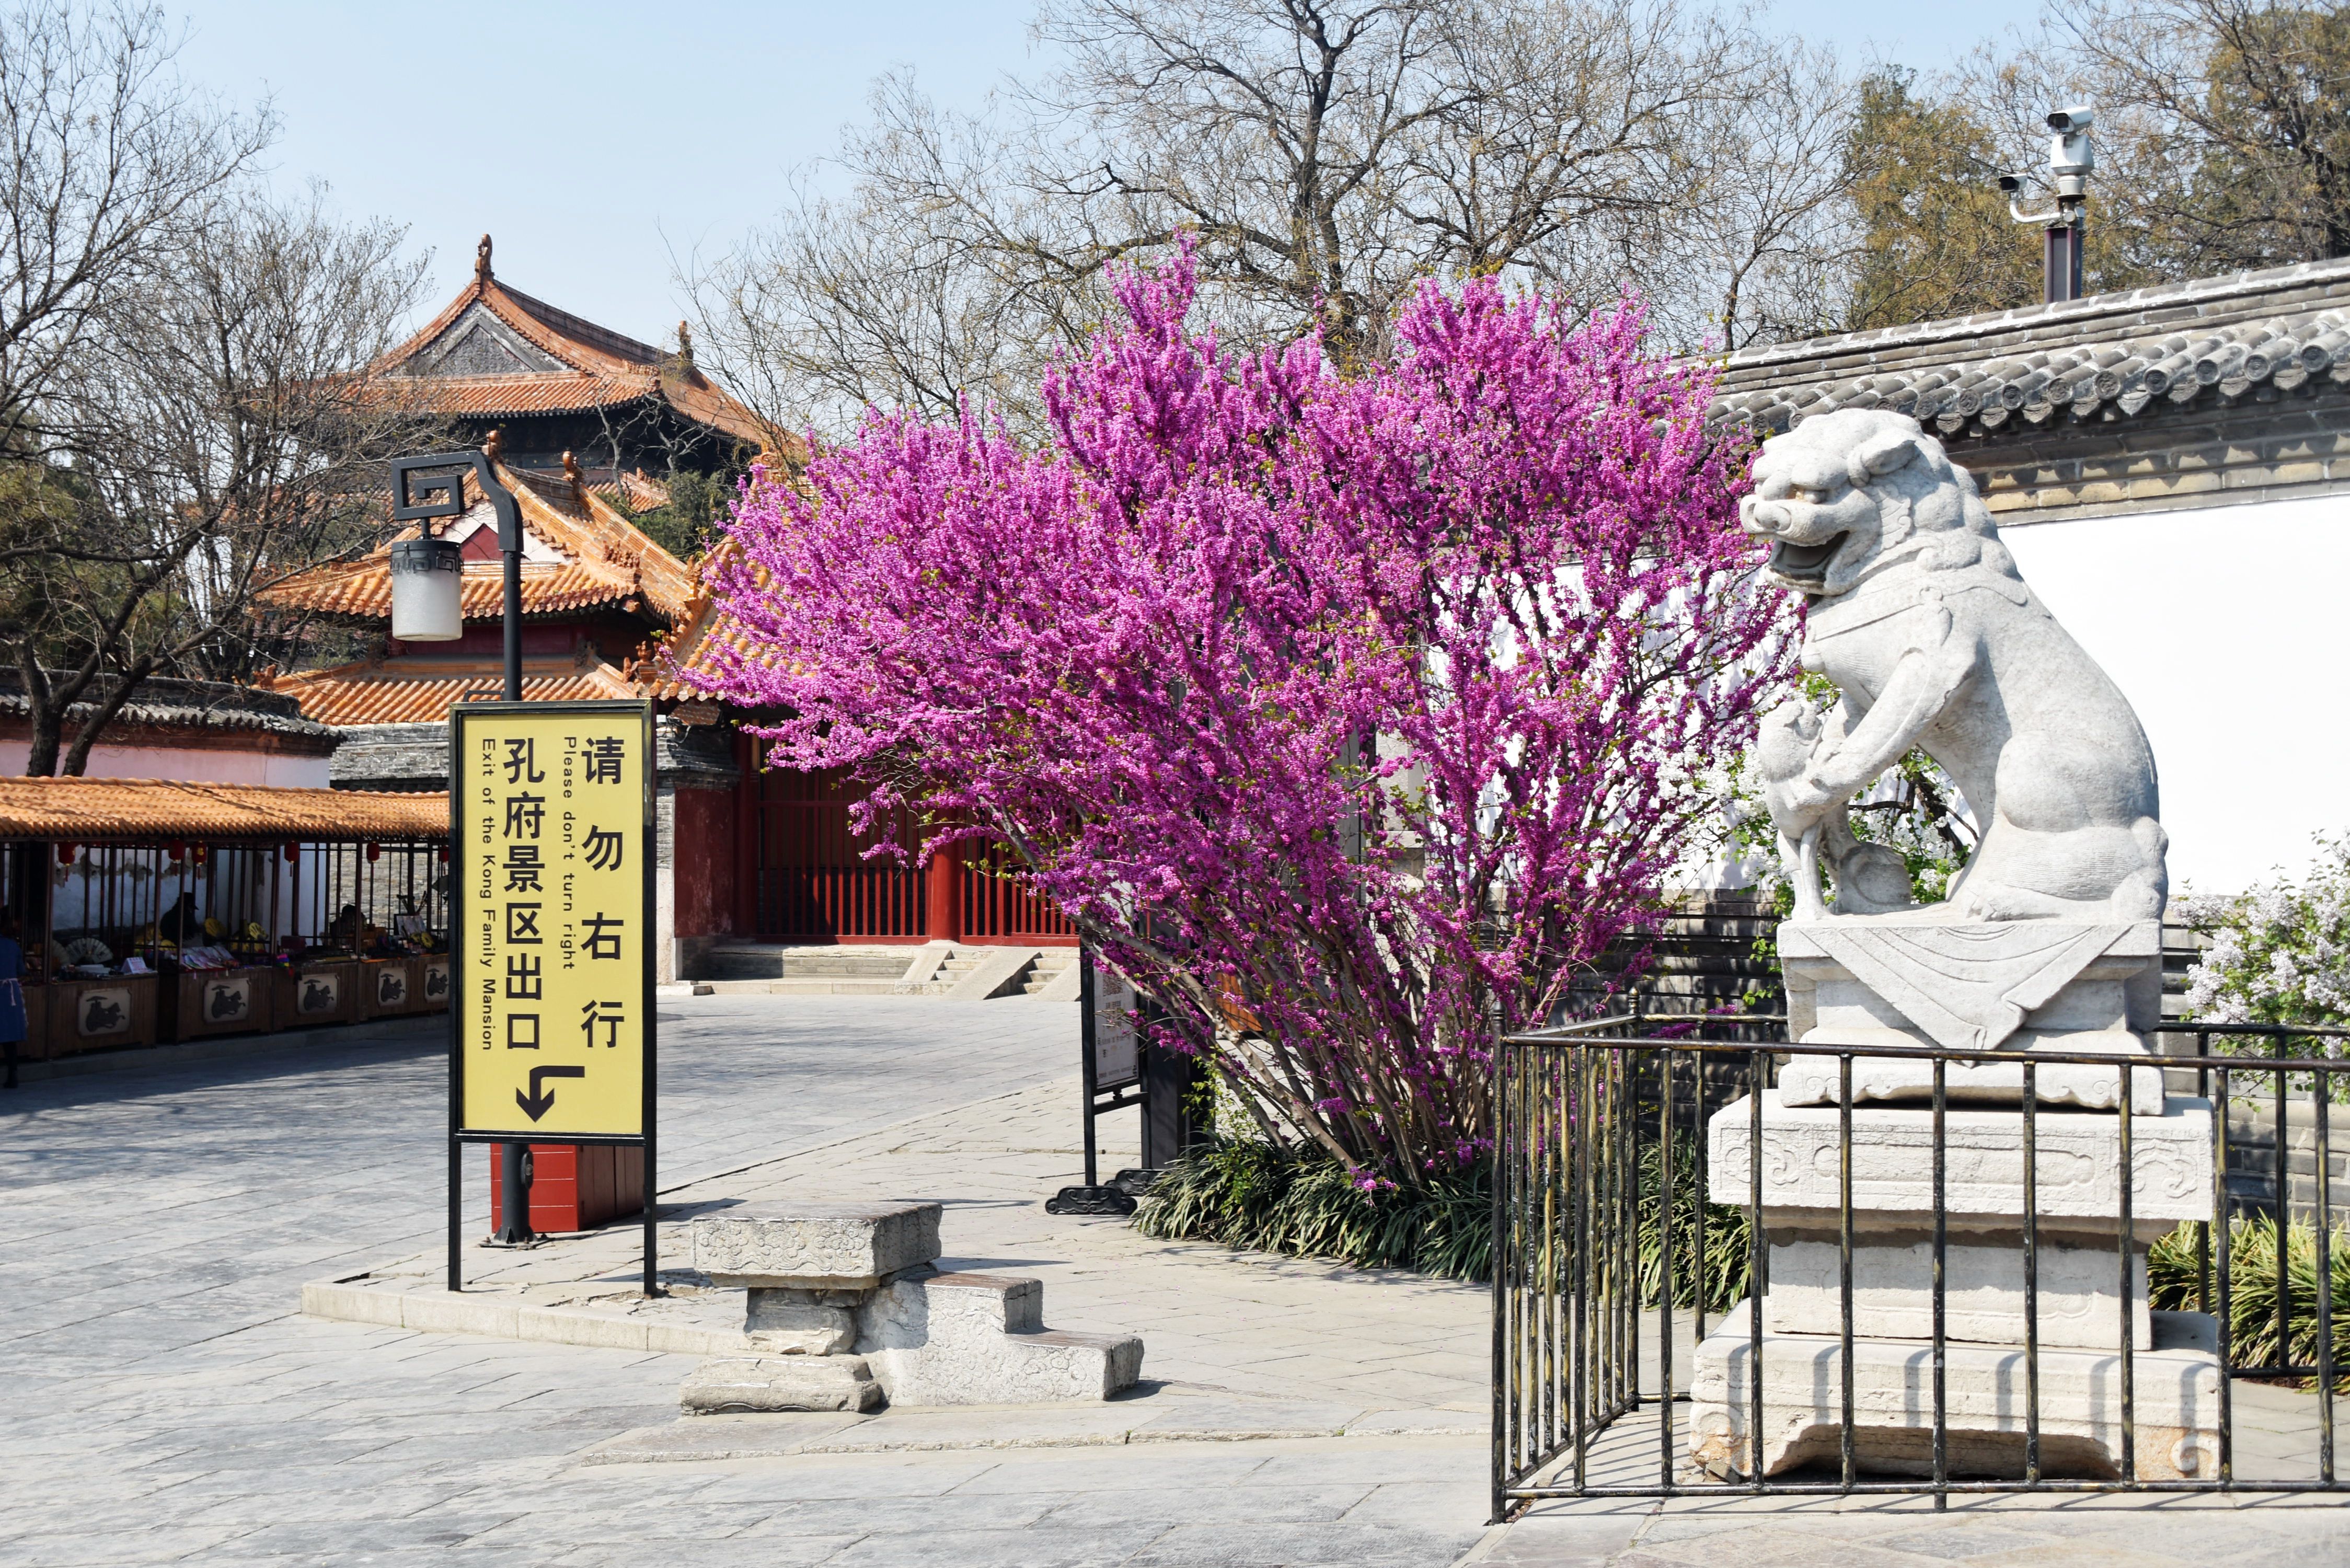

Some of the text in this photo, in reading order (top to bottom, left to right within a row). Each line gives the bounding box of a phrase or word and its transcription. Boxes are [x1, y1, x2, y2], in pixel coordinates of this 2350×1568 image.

[479, 739, 496, 1050] Exit of the Kong Family Mansion
[503, 737, 546, 1050] 孔府景区出口
[560, 736, 577, 969] Please don't turn right
[581, 736, 625, 1048] 请勿右行
